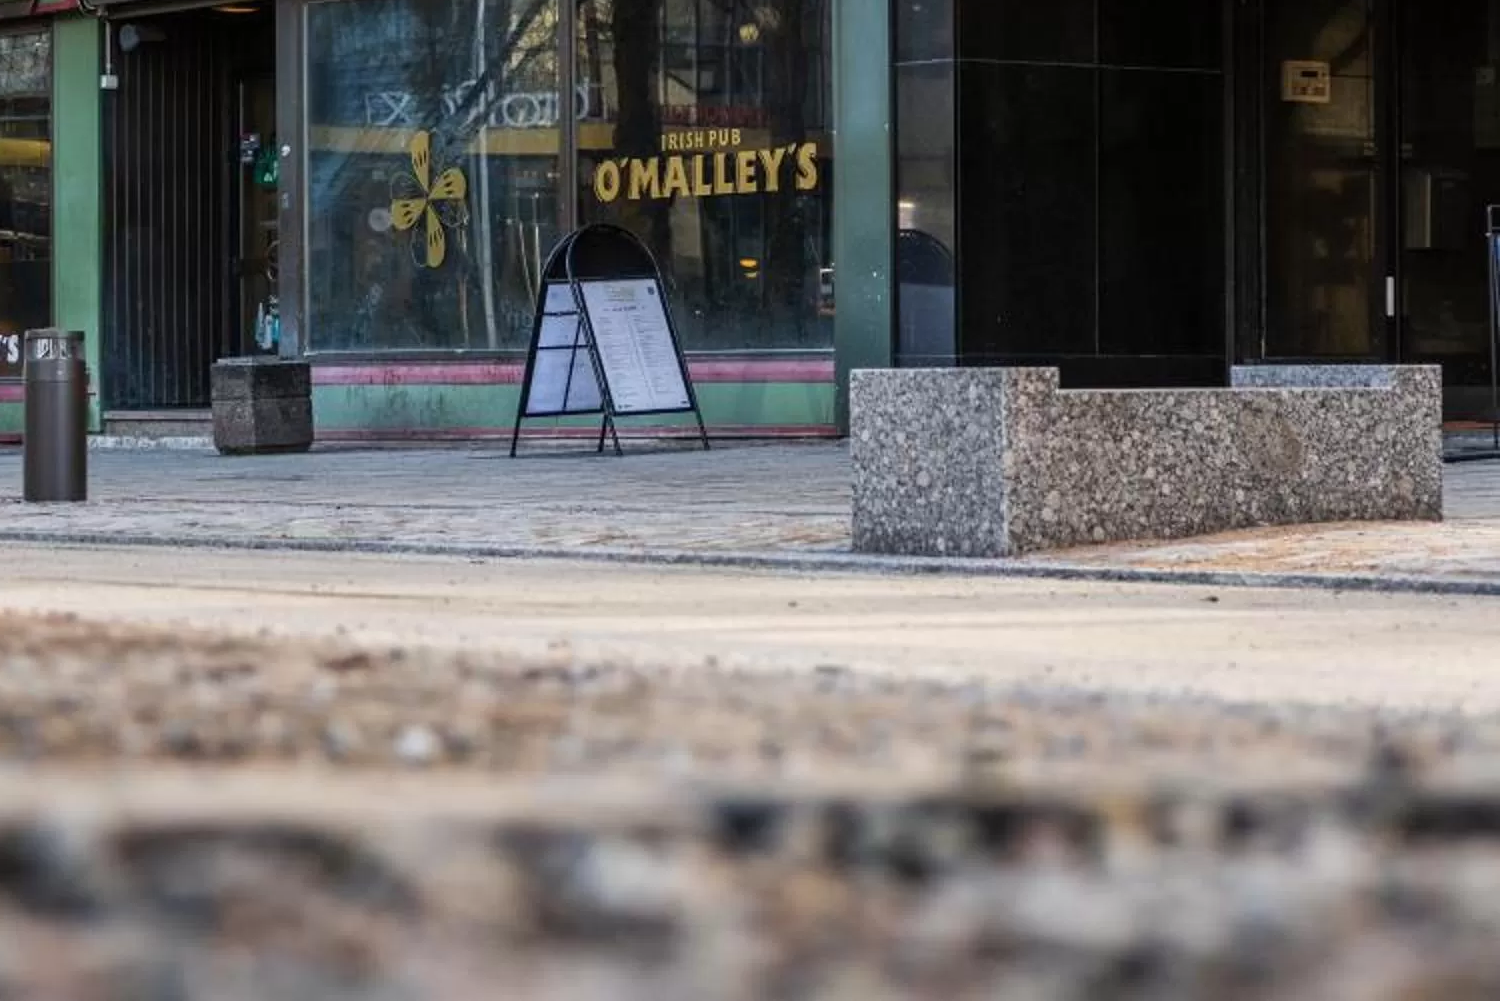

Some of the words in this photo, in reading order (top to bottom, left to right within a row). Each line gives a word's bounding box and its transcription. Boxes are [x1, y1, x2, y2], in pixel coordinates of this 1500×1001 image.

[661, 132, 704, 151] IRISH
[709, 128, 741, 147] PUB
[593, 142, 817, 203] O'MALLEY'S
